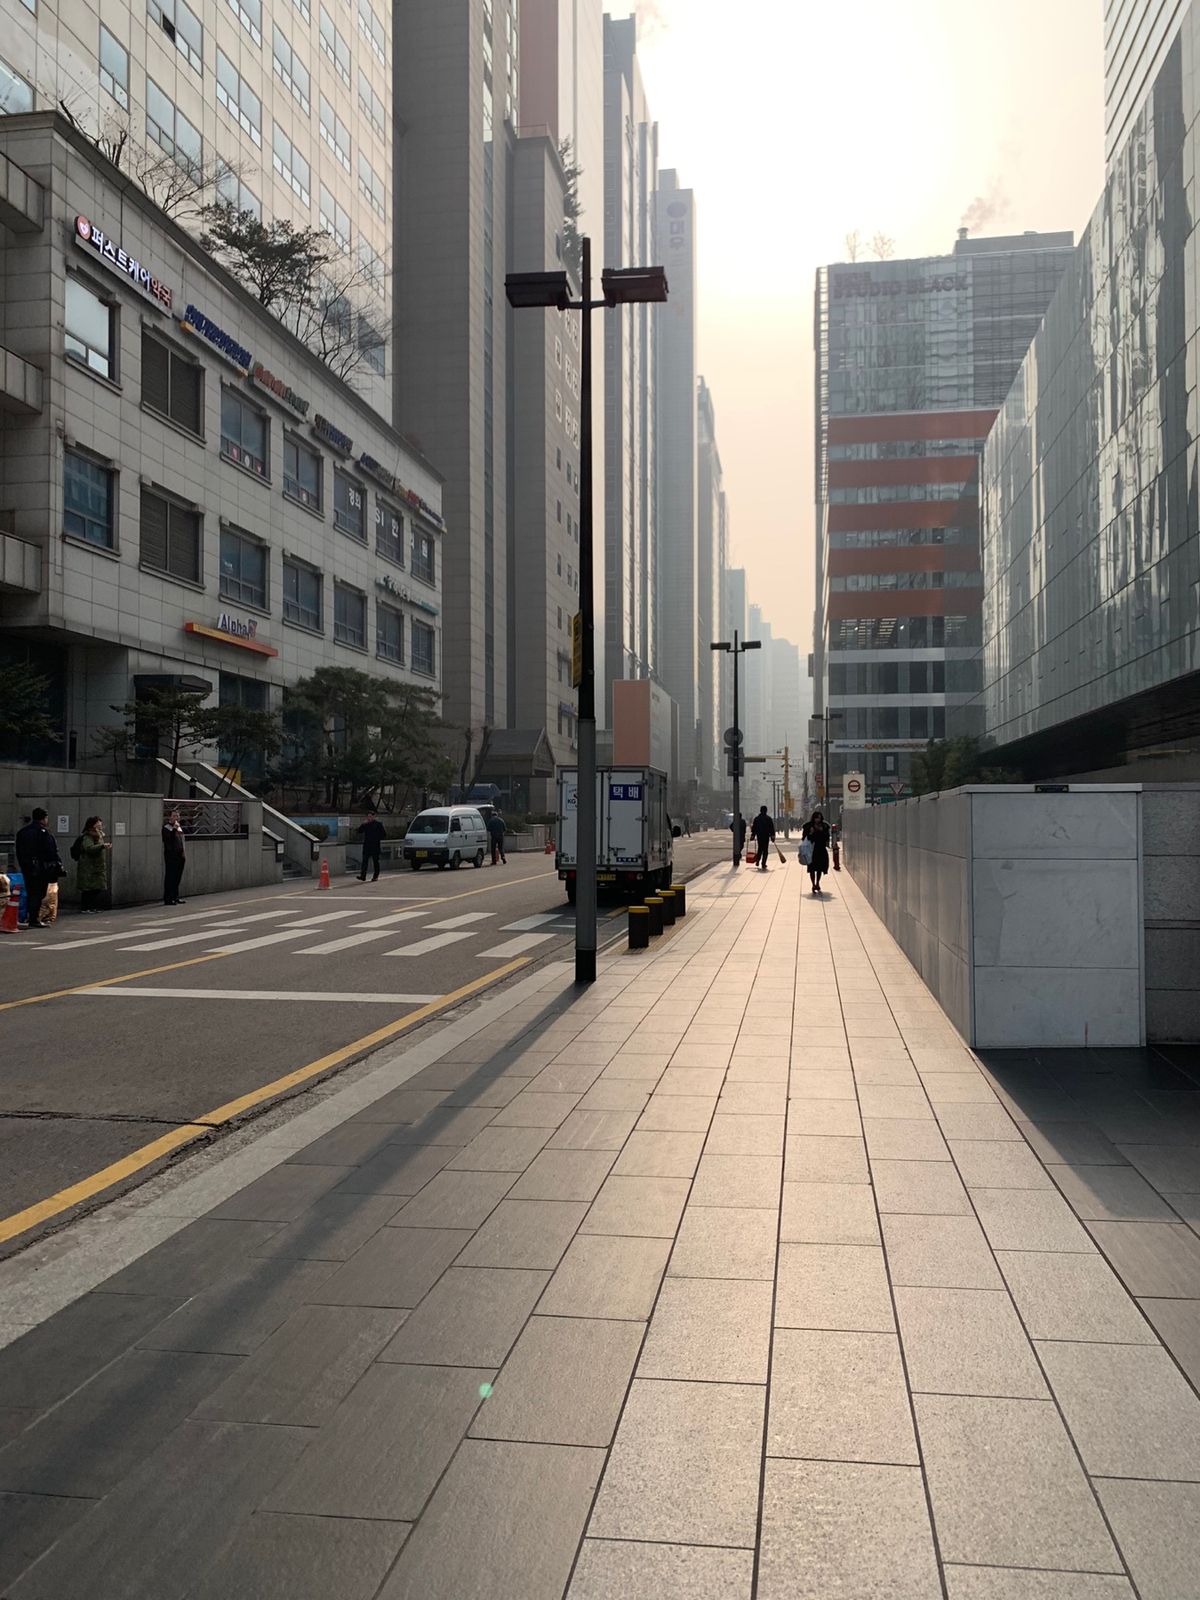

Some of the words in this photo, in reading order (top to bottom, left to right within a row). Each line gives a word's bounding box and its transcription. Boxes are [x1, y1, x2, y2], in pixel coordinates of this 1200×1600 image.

[91, 225, 172, 309] 퍼스트케어약국
[906, 275, 969, 296] BLACK
[220, 613, 249, 636] Alpha
